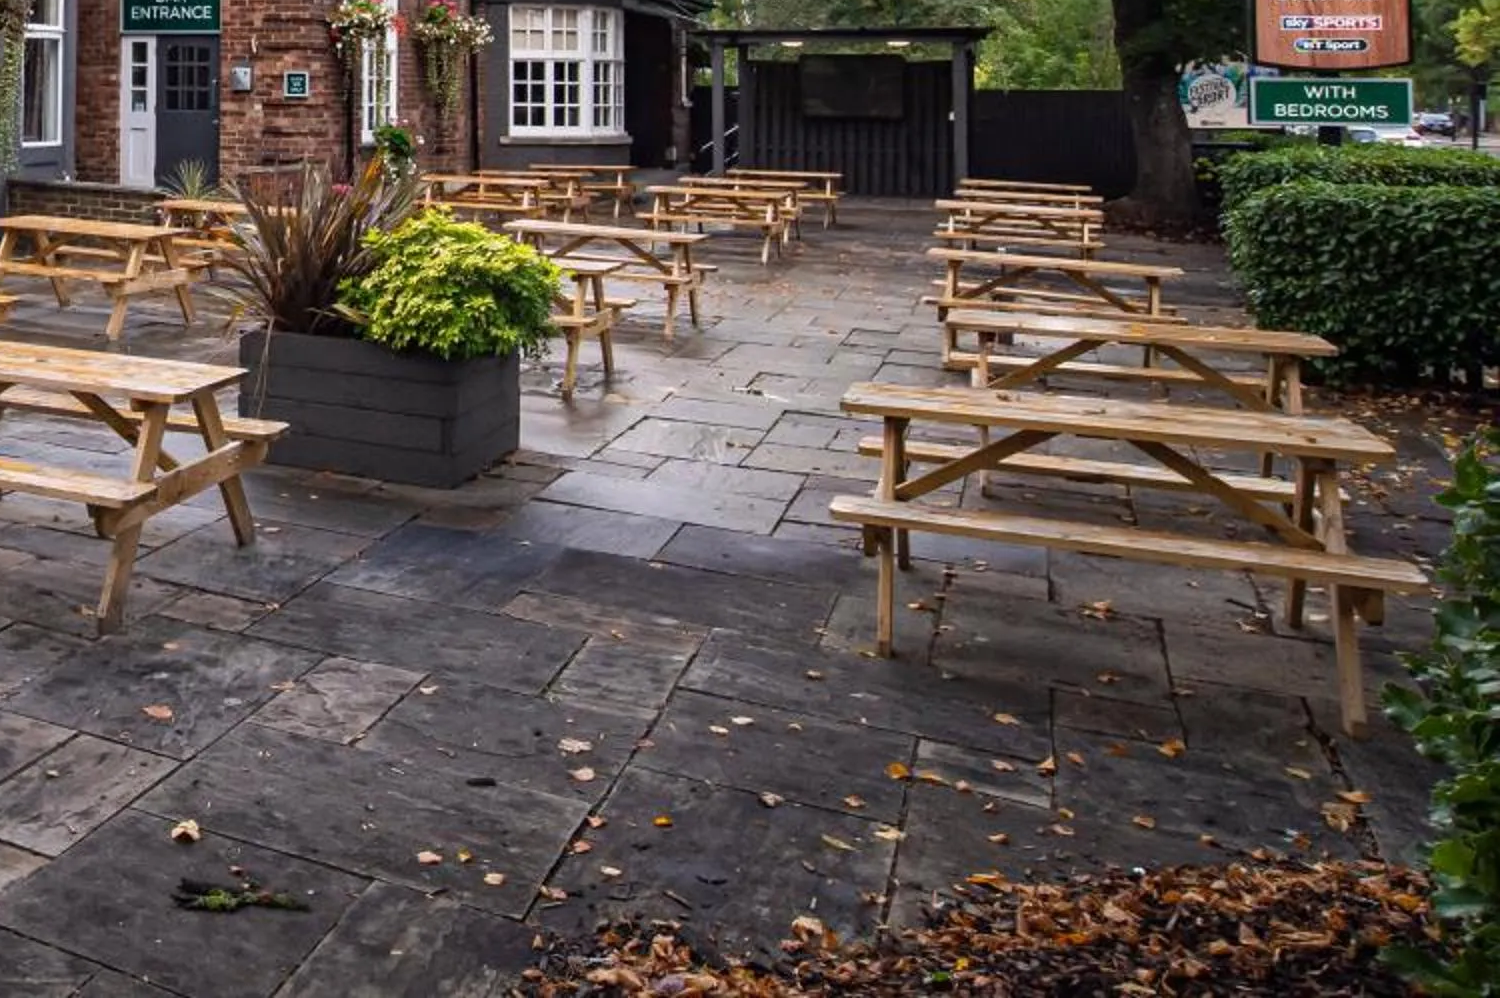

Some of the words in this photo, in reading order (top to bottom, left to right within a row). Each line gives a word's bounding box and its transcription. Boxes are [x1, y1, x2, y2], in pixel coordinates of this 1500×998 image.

[131, 5, 213, 20] ENTRANCE
[1303, 85, 1357, 99] WITH
[1274, 103, 1389, 119] BEDROOMS
